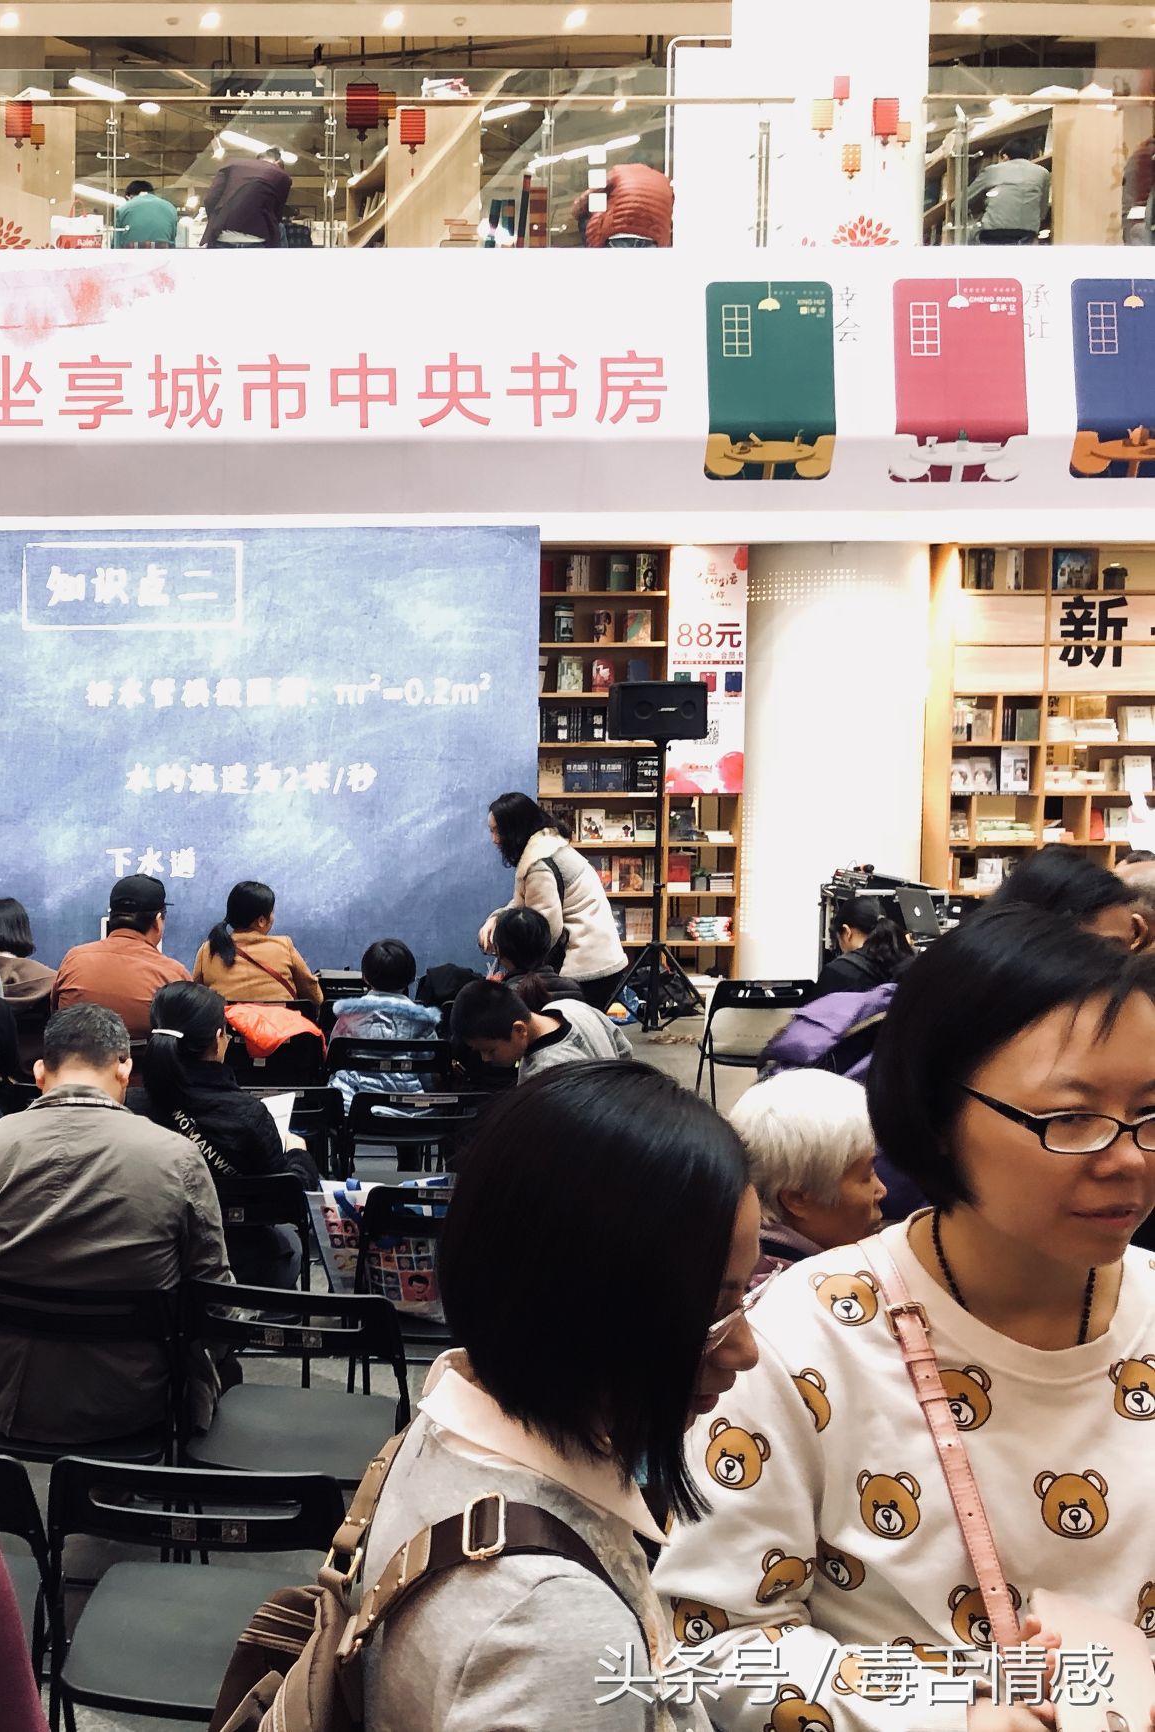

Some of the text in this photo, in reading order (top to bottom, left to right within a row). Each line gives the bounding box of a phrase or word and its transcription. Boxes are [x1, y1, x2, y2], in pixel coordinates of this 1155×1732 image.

[677, 623, 742, 648] 88元
[105, 847, 197, 879] 下水道
